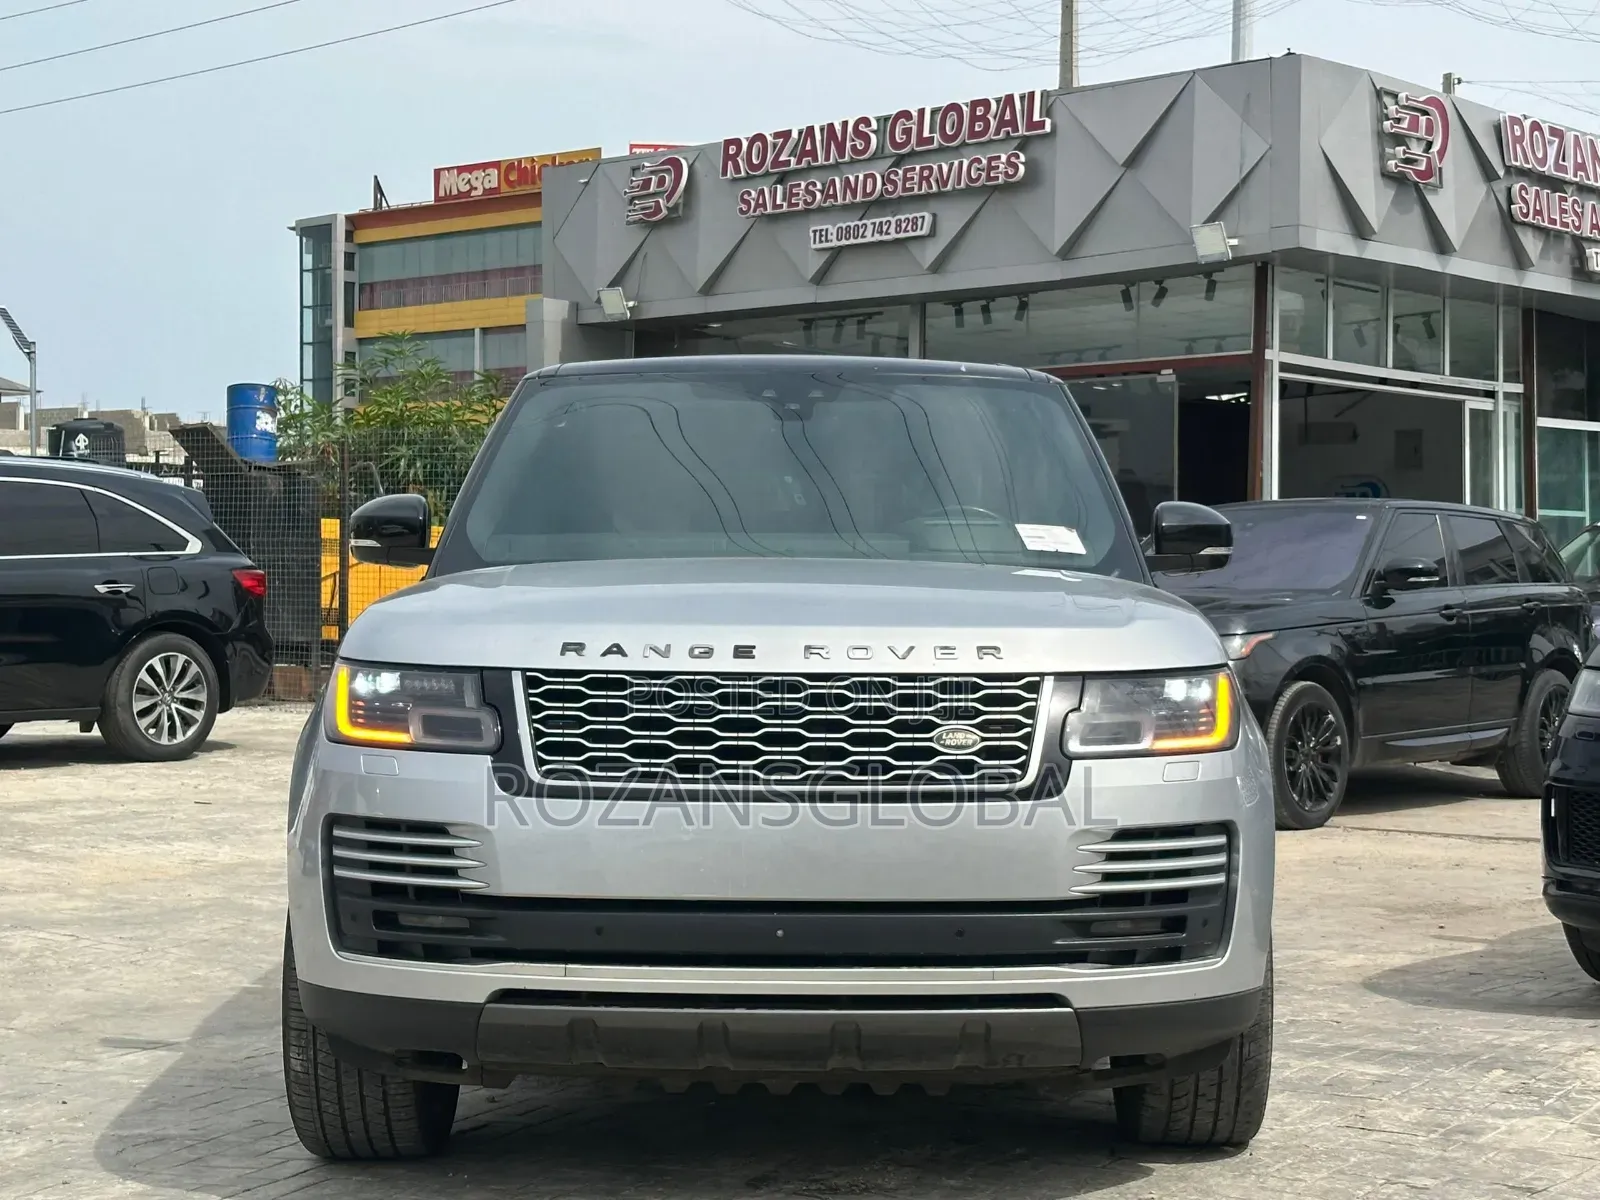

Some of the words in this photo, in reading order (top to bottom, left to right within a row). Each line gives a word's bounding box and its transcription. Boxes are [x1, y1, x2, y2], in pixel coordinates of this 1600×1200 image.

[720, 116, 877, 180] ROZANS
[887, 90, 1052, 154] GLOBAL
[438, 166, 498, 198] Mega
[737, 180, 822, 218] SALES
[821, 171, 882, 206] AND
[882, 151, 1026, 198] SERVICES
[1511, 182, 1583, 235] SALES
[811, 228, 834, 245] TEL:
[836, 224, 868, 242] 0802
[870, 219, 892, 238] 742
[894, 215, 926, 234] 8287
[560, 642, 756, 659] RANGE
[804, 644, 1004, 660] ROVER
[942, 732, 966, 740] LAND
[944, 738, 973, 746] ROVER
